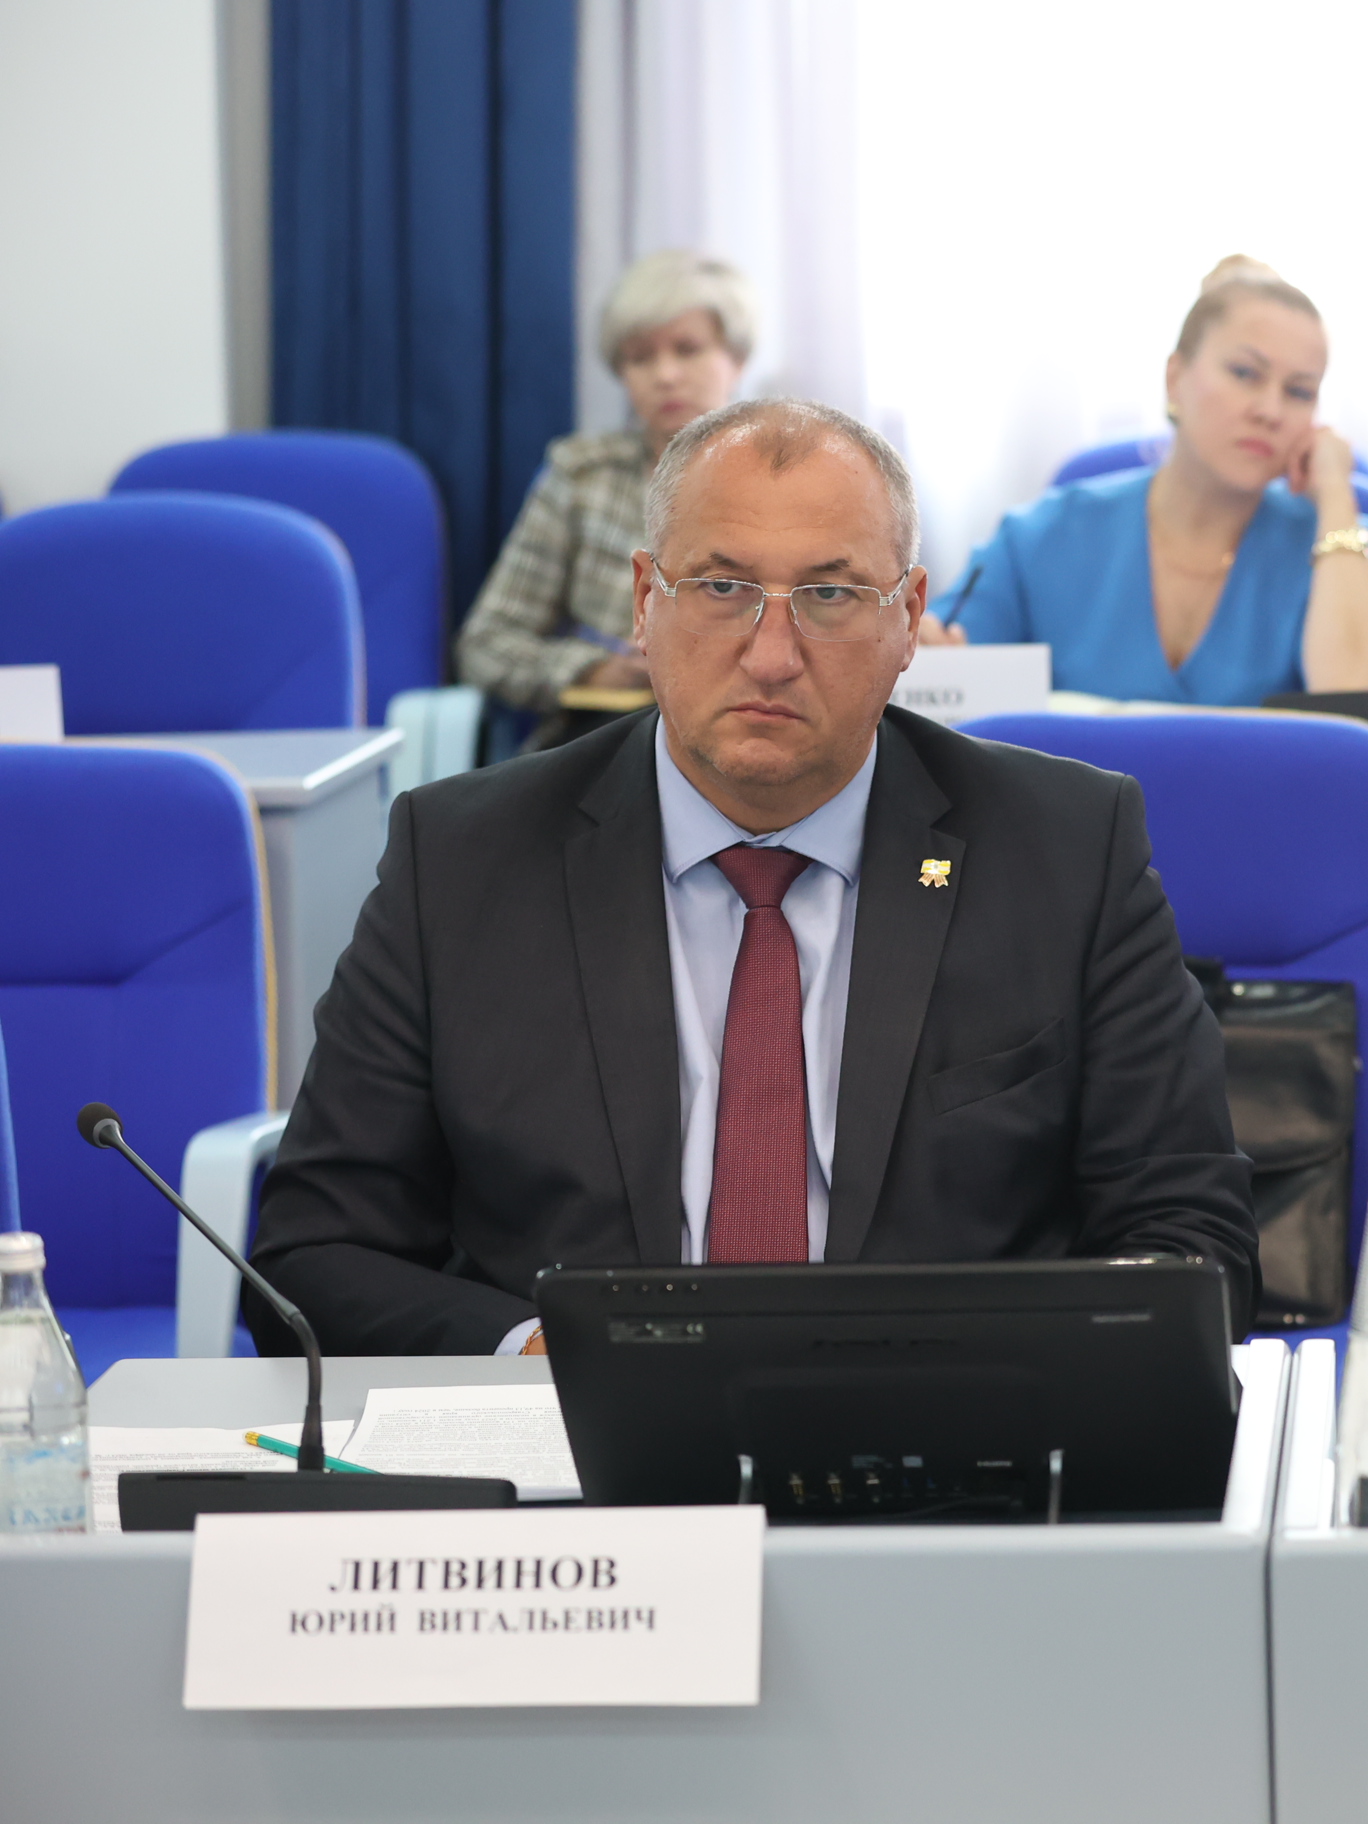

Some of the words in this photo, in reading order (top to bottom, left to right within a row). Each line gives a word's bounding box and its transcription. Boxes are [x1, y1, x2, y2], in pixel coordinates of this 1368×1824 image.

[330, 1555, 619, 1592] ЛИТВИНОВ
[289, 1603, 397, 1635] ЮРИЙ
[418, 1606, 657, 1633] ВИТАЛЬЕВИЧ
